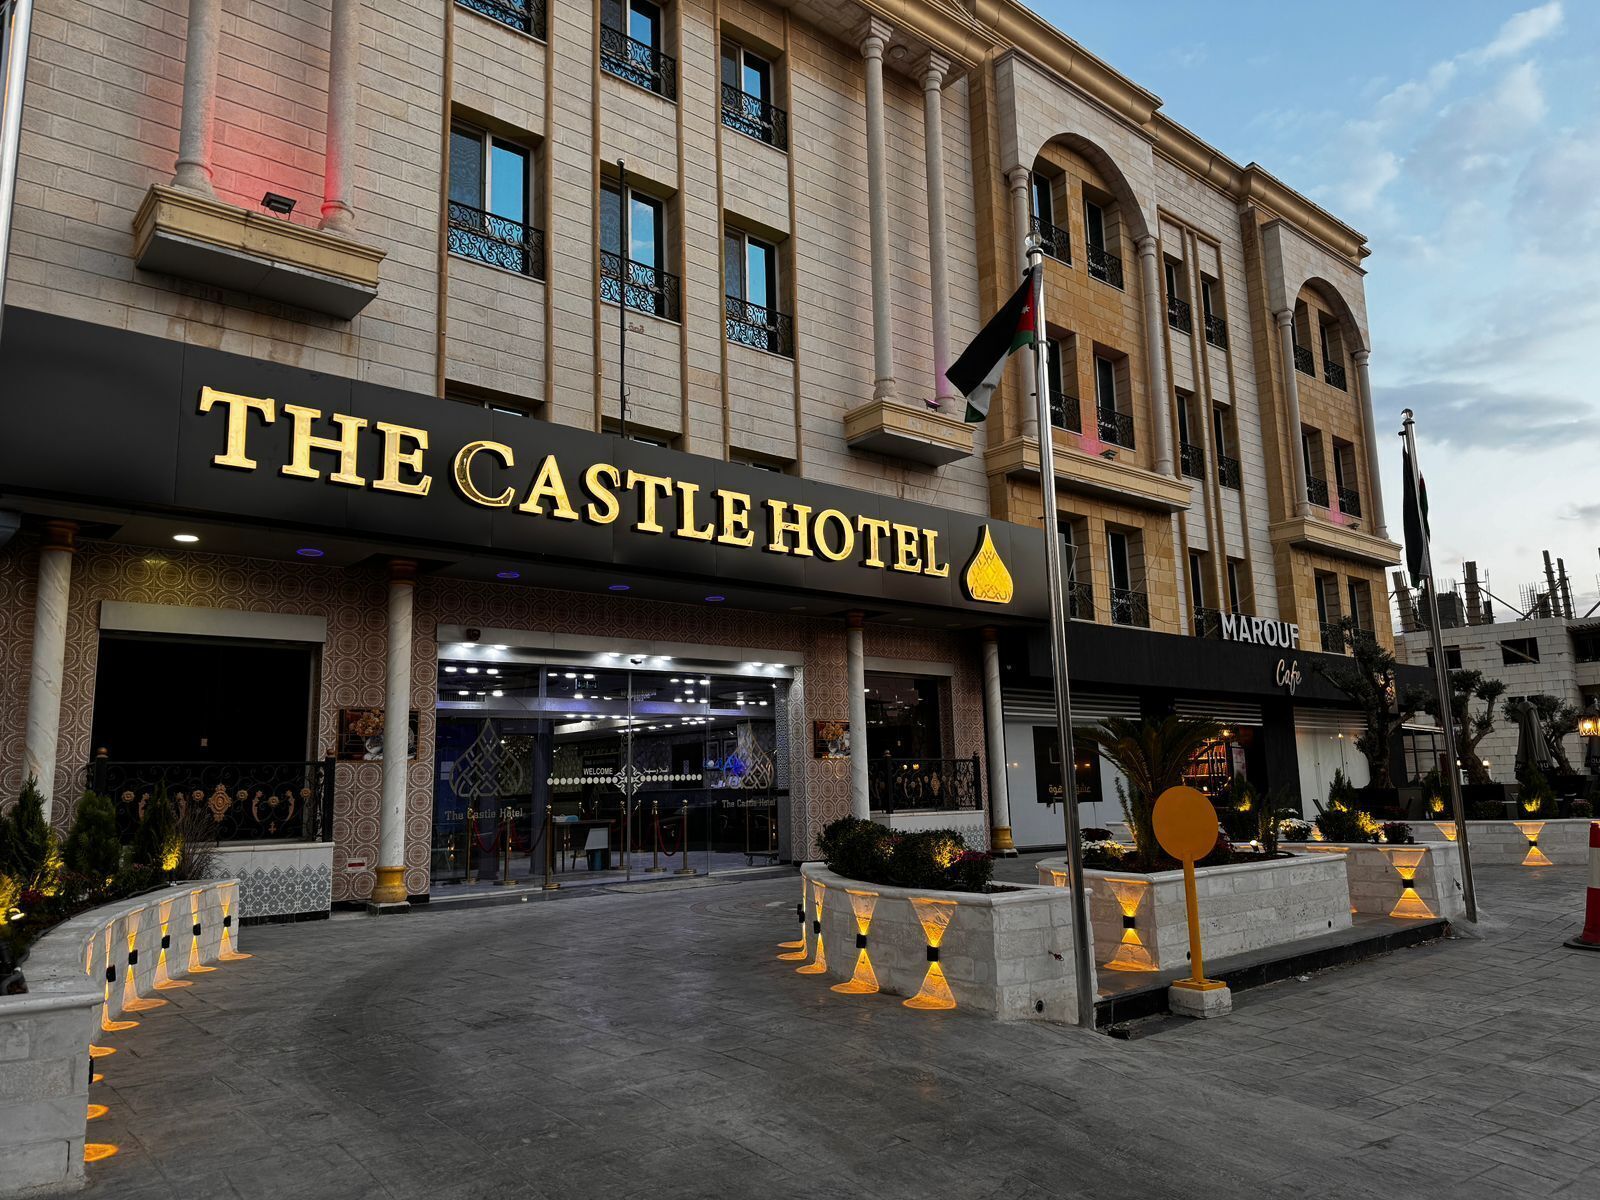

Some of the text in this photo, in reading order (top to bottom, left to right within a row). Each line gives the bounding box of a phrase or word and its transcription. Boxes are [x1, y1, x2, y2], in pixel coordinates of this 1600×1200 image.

[199, 385, 950, 578] THE CASTLE HOTEL
[1220, 611, 1299, 649] MAROUF
[1276, 659, 1302, 695] Cafe
[583, 767, 613, 775] WELCOME
[444, 810, 464, 821] The
